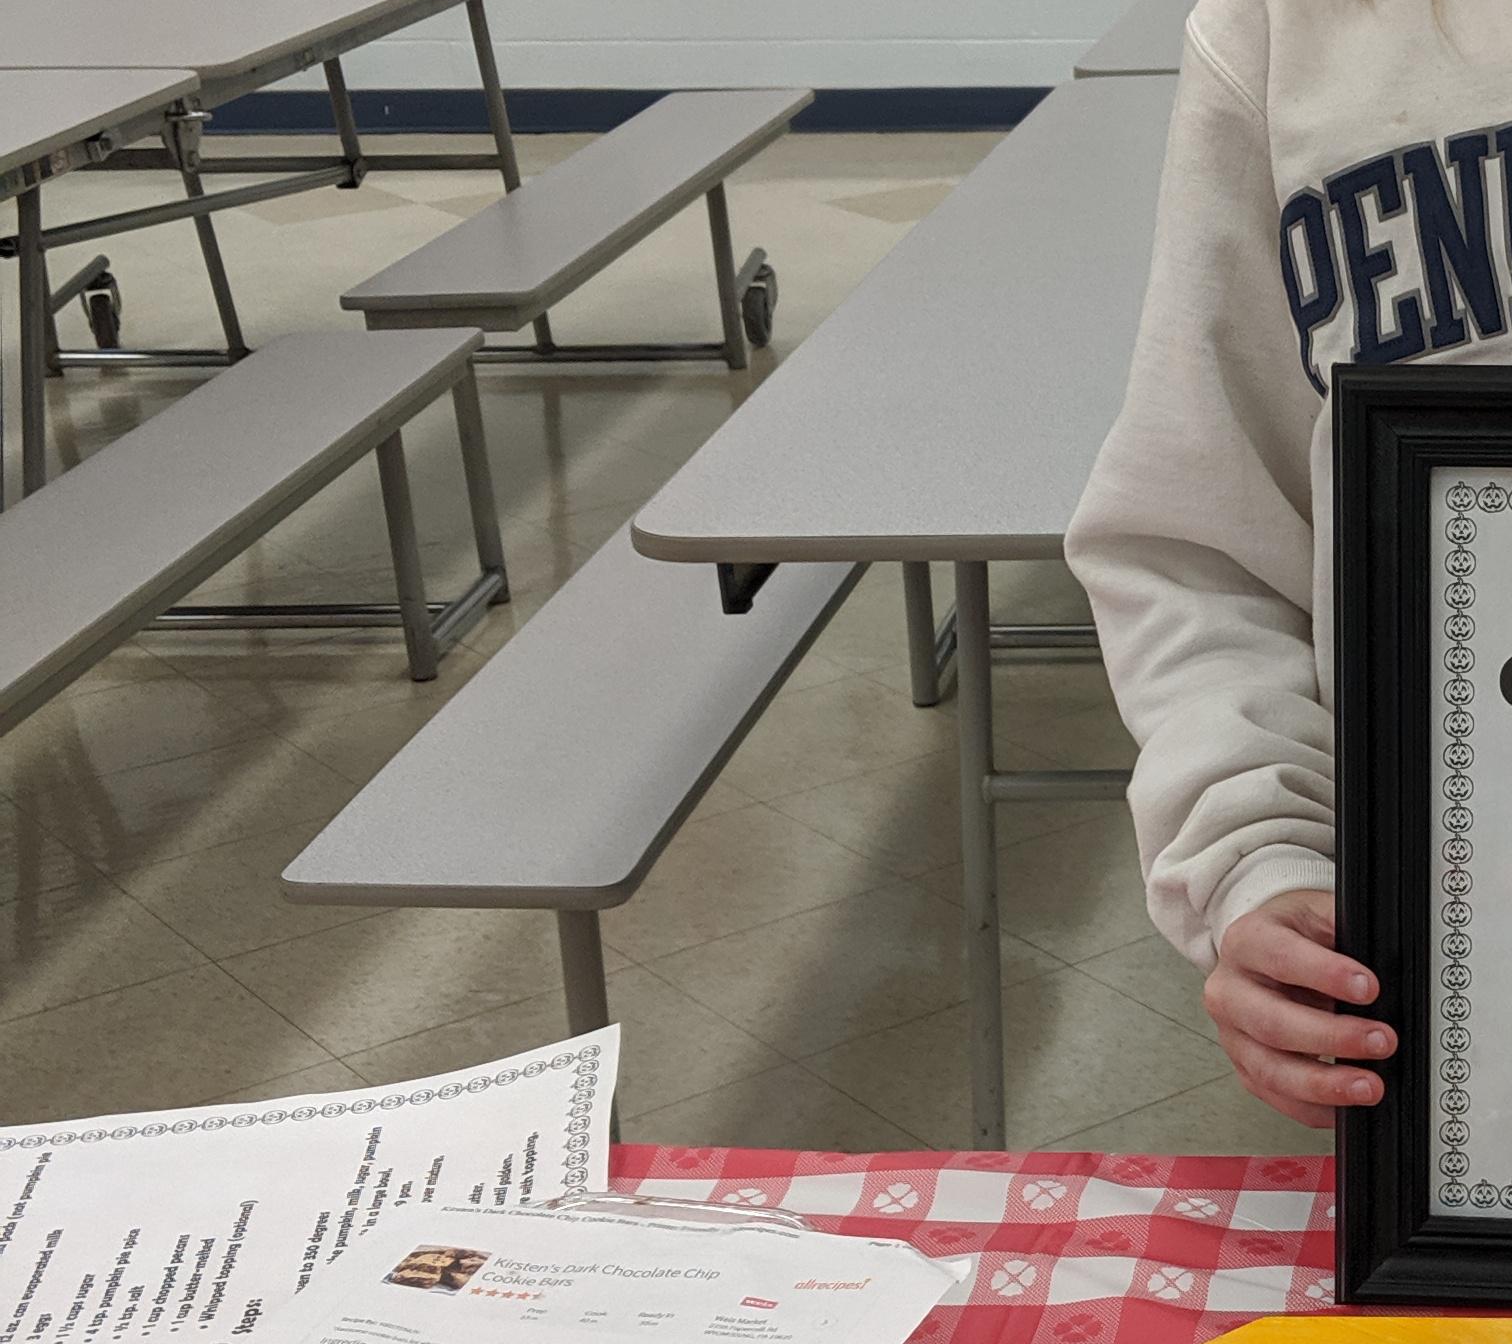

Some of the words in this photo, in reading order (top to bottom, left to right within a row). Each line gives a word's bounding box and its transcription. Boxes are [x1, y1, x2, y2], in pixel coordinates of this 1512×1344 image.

[521, 1131, 540, 1176] topping.
[373, 1168, 394, 1188] bowl.
[496, 1153, 514, 1186] golden.
[366, 1189, 387, 1210] large
[468, 1182, 486, 1205] utter.
[227, 1200, 260, 1242] (optional)
[307, 1211, 331, 1243] degrees
[334, 1207, 358, 1248] pumpkin,
[361, 1218, 377, 1227] in
[45, 1228, 64, 1249] milk
[123, 1228, 141, 1250] spice
[170, 1234, 191, 1264] pecans
[115, 1251, 132, 1266] pie
[216, 1243, 242, 1280] topping
[302, 1245, 320, 1261] 350
[21, 1249, 54, 1300] evaporated
[178, 1238, 216, 1302] butter-melted
[298, 1262, 315, 1273] to
[492, 1257, 561, 1274] Kirsten's
[562, 1263, 600, 1274] Dark
[601, 1264, 682, 1279] Chocolate
[683, 1268, 721, 1281] Chip
[75, 1273, 96, 1299] sugar
[99, 1266, 126, 1309] pumpkin
[152, 1266, 179, 1304] chopped
[481, 1271, 537, 1287] Cookie
[538, 1278, 575, 1288] Bars
[128, 1285, 145, 1302] salt
[198, 1280, 228, 1322] Whipped
[13, 1302, 30, 1318] can
[66, 1300, 85, 1321] cups
[147, 1306, 166, 1323] cup
[176, 1303, 194, 1319] cup
[231, 1298, 263, 1335] Steps:
[33, 1313, 52, 1333] eggs
